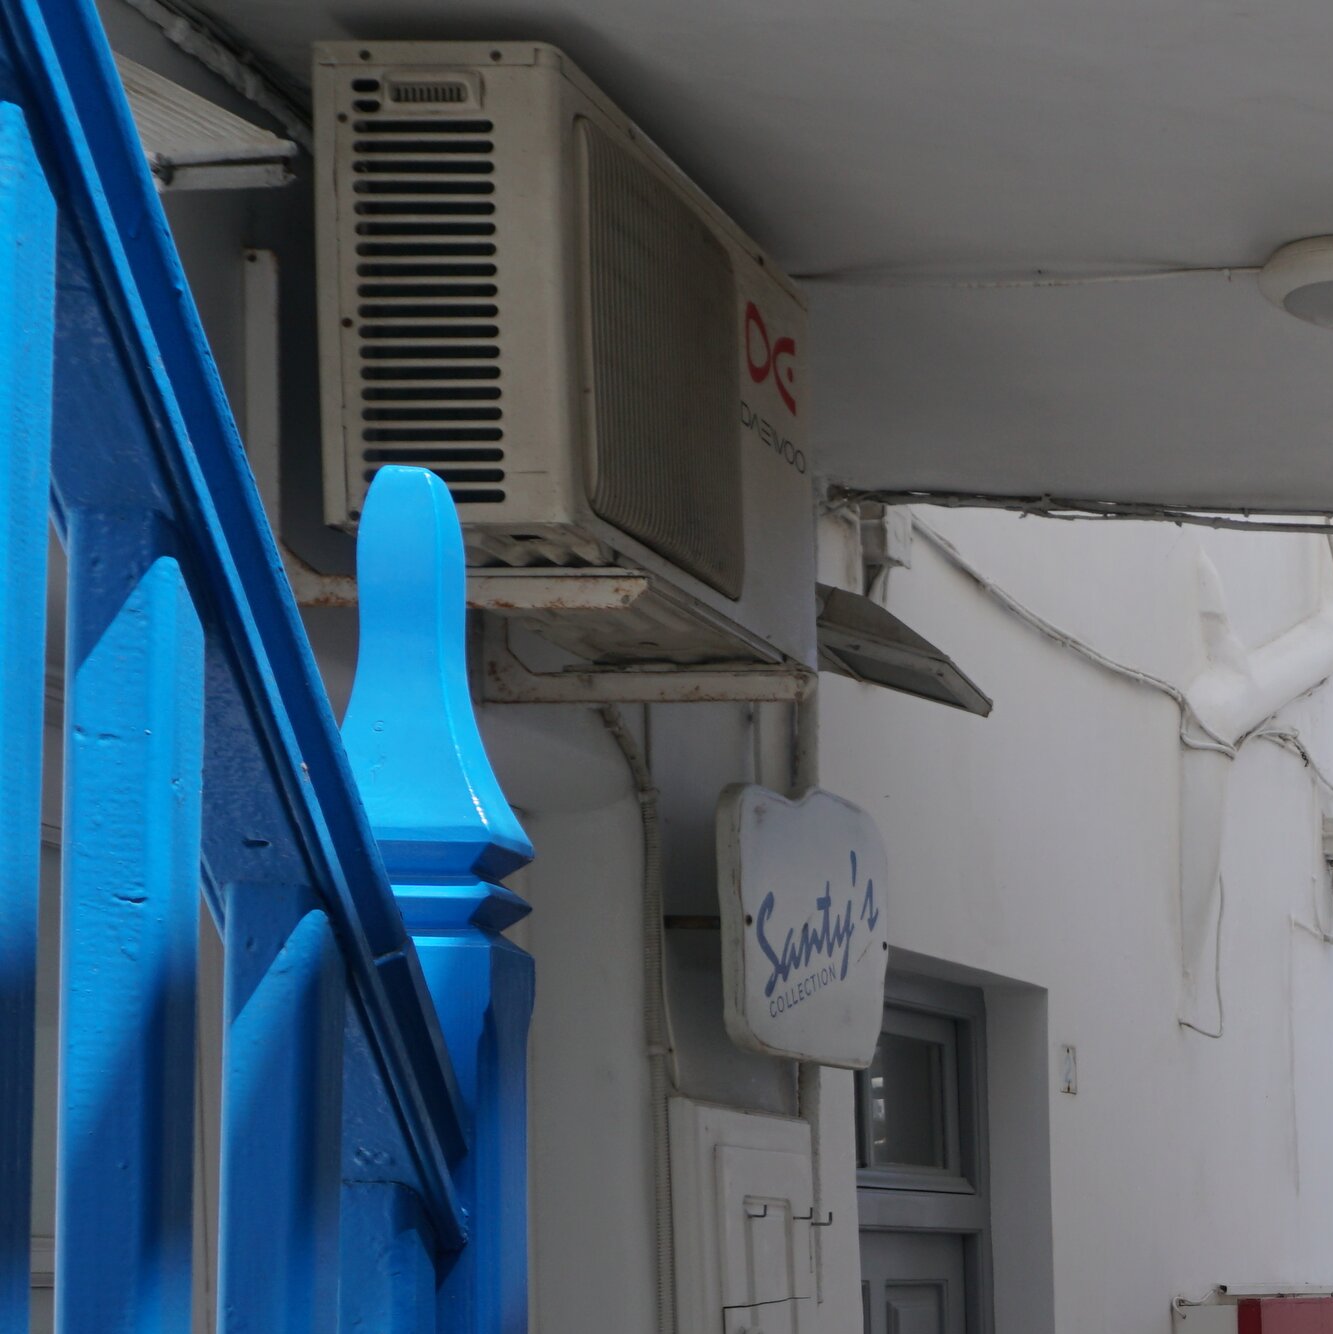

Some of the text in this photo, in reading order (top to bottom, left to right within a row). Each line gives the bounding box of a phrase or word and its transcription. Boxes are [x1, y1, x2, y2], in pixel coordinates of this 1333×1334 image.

[740, 399, 807, 475] DAEWOO
[756, 849, 880, 998] Santy's
[769, 964, 837, 1018] COLLECTION
